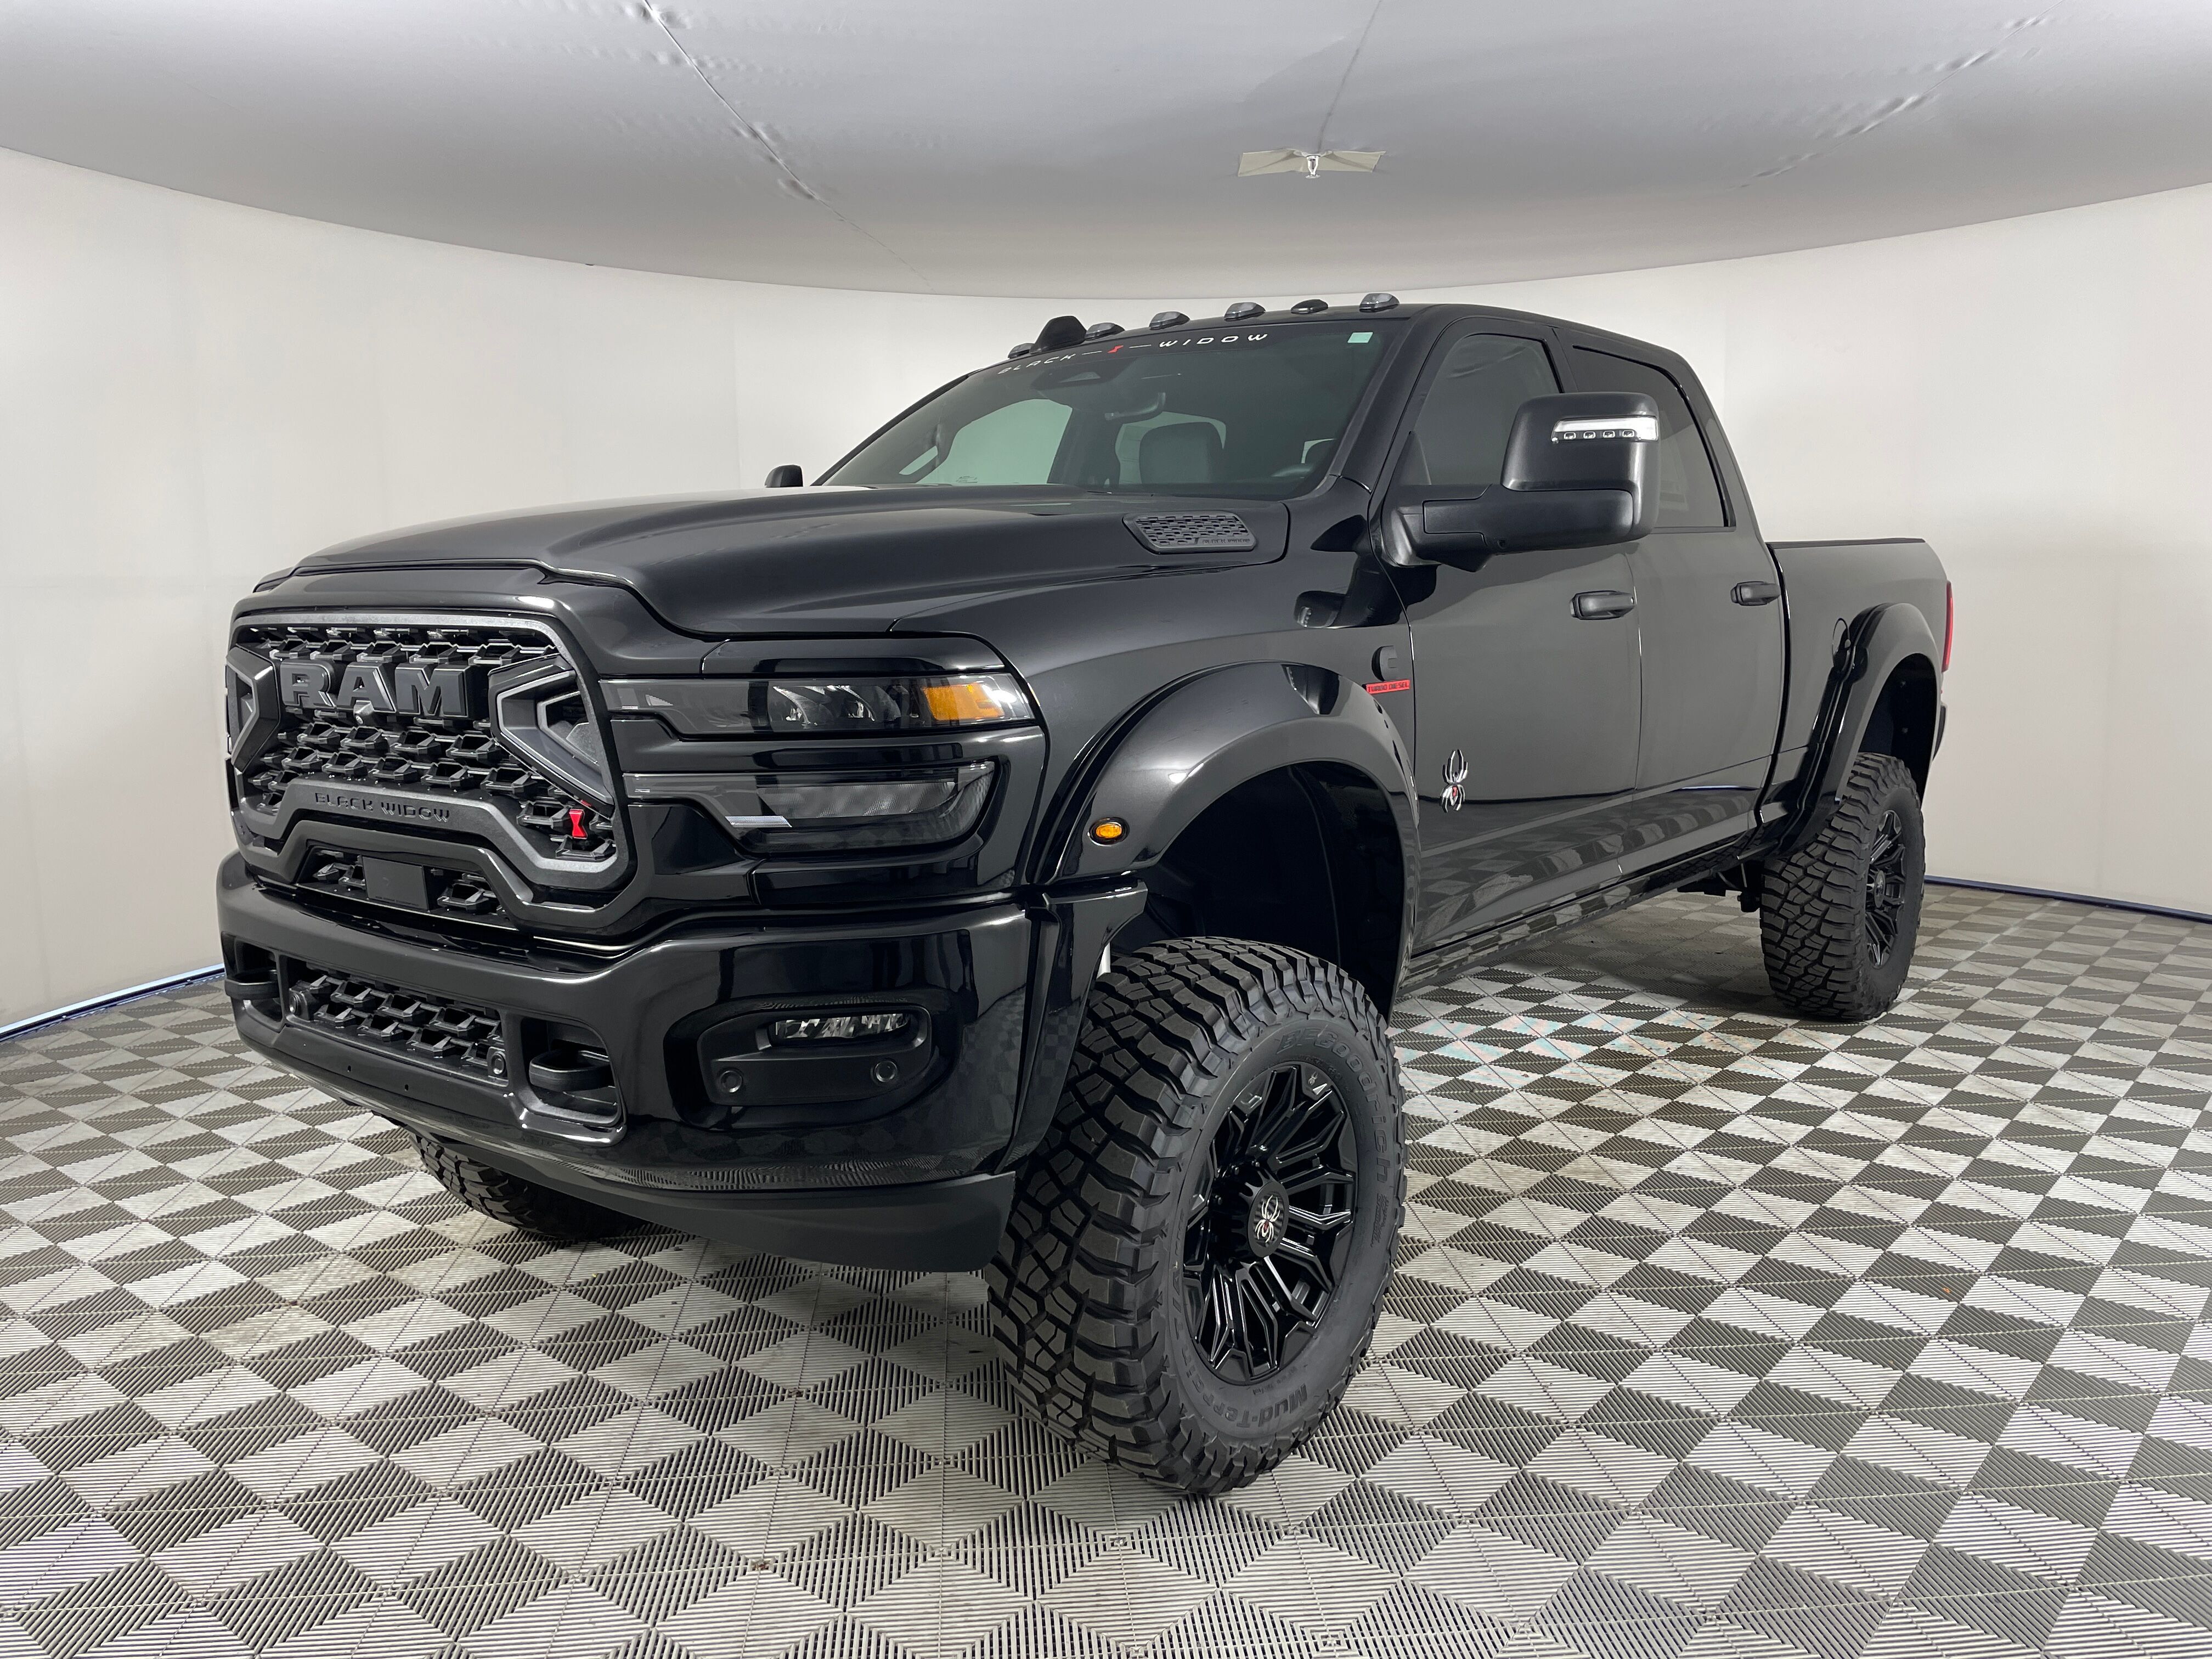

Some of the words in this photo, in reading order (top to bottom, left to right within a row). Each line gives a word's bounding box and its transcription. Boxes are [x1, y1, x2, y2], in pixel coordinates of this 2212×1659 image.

[997, 353, 1076, 375] BLACK
[1159, 334, 1268, 347] WIDOW
[280, 661, 470, 718] RAM
[315, 792, 374, 812] BLACK
[381, 802, 450, 823] WIDOW
[1276, 1026, 1391, 1184] BFGoodrich
